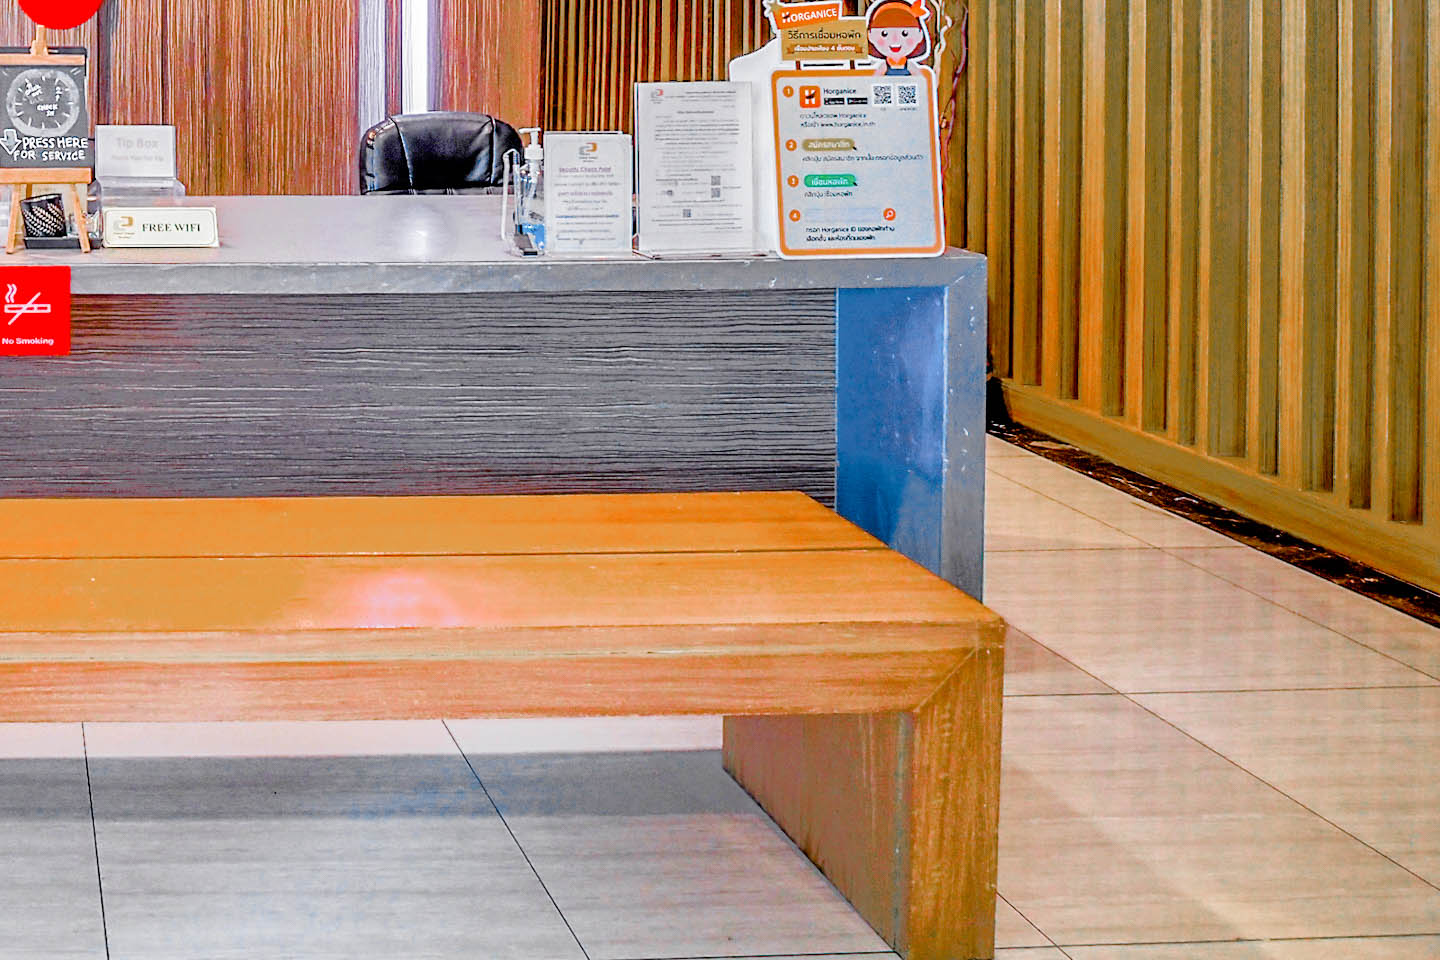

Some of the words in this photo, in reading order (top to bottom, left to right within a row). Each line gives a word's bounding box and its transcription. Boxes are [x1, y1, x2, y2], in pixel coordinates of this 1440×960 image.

[781, 7, 838, 23] HORGANICE
[823, 88, 857, 96] Horganice
[22, 136, 55, 149] PRESS
[56, 137, 89, 149] HERE
[13, 149, 37, 161] FOR
[41, 149, 86, 161] SERVICE
[142, 223, 172, 232] FREE
[174, 223, 201, 232] WIFI
[1, 337, 14, 345] No
[15, 337, 55, 346] Smoking
